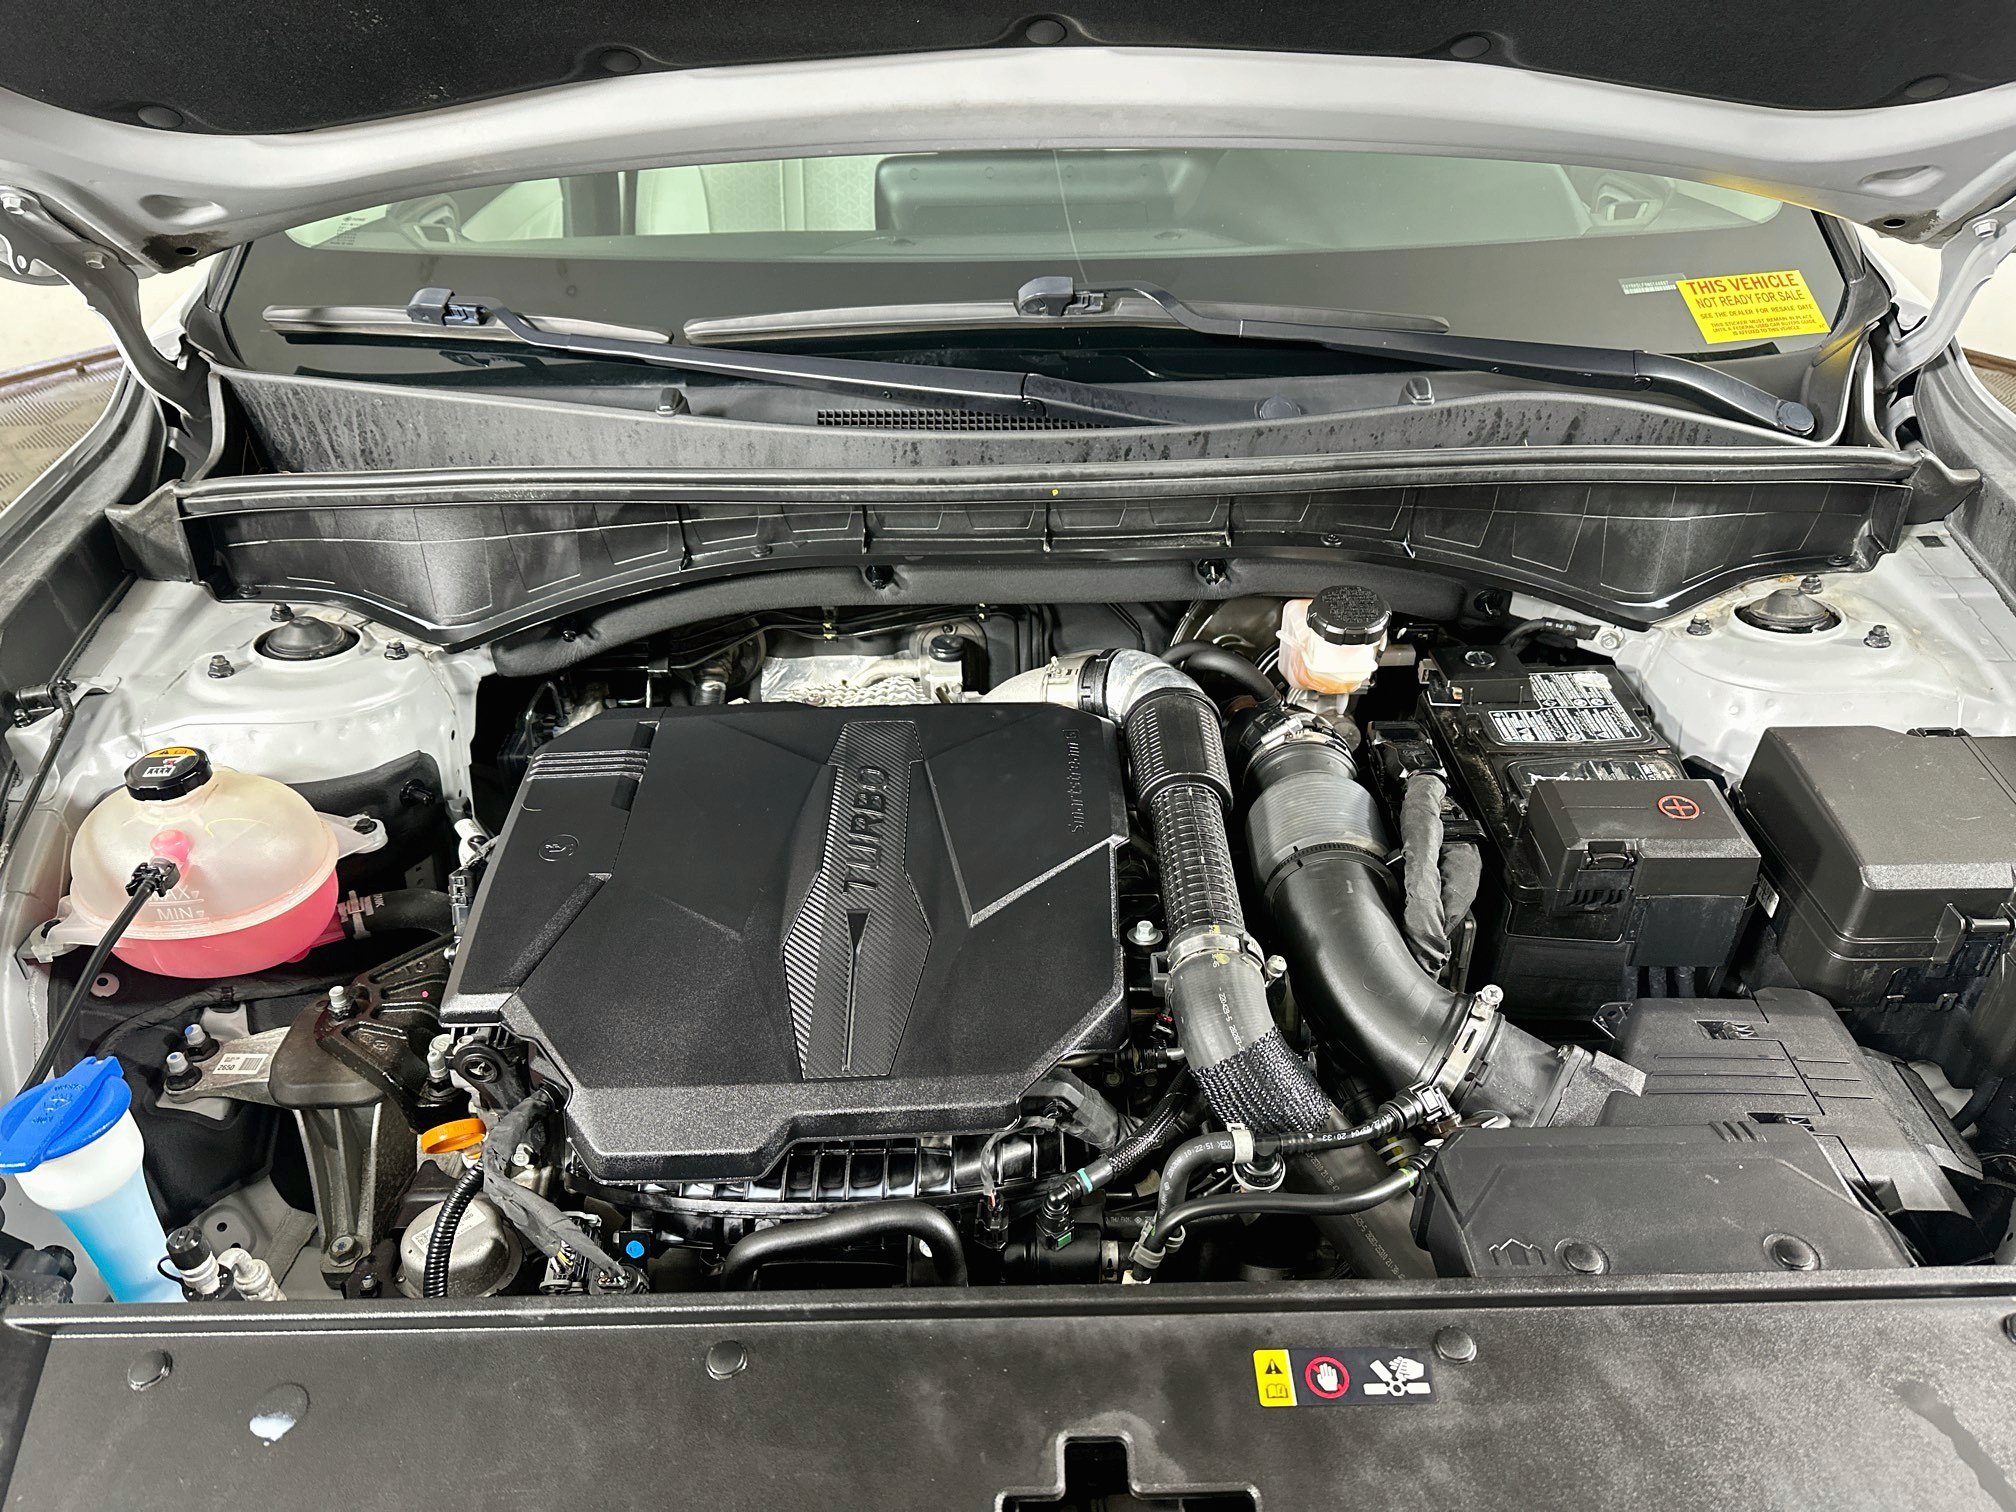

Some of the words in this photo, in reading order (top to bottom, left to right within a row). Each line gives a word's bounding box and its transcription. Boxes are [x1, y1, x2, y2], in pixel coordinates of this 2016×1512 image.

[1686, 280, 1727, 296] THIS
[1728, 273, 1799, 292] VEHICLE
[1695, 297, 1718, 309] NOT
[1719, 293, 1754, 307] READY
[1755, 291, 1777, 304] FOR
[1778, 289, 1806, 301] SALE
[1729, 309, 1754, 317] DEALER
[1770, 305, 1796, 313] RESALE
[1798, 303, 1814, 311] DATE
[843, 765, 889, 894] TURBO
[157, 907, 194, 920] MIN
